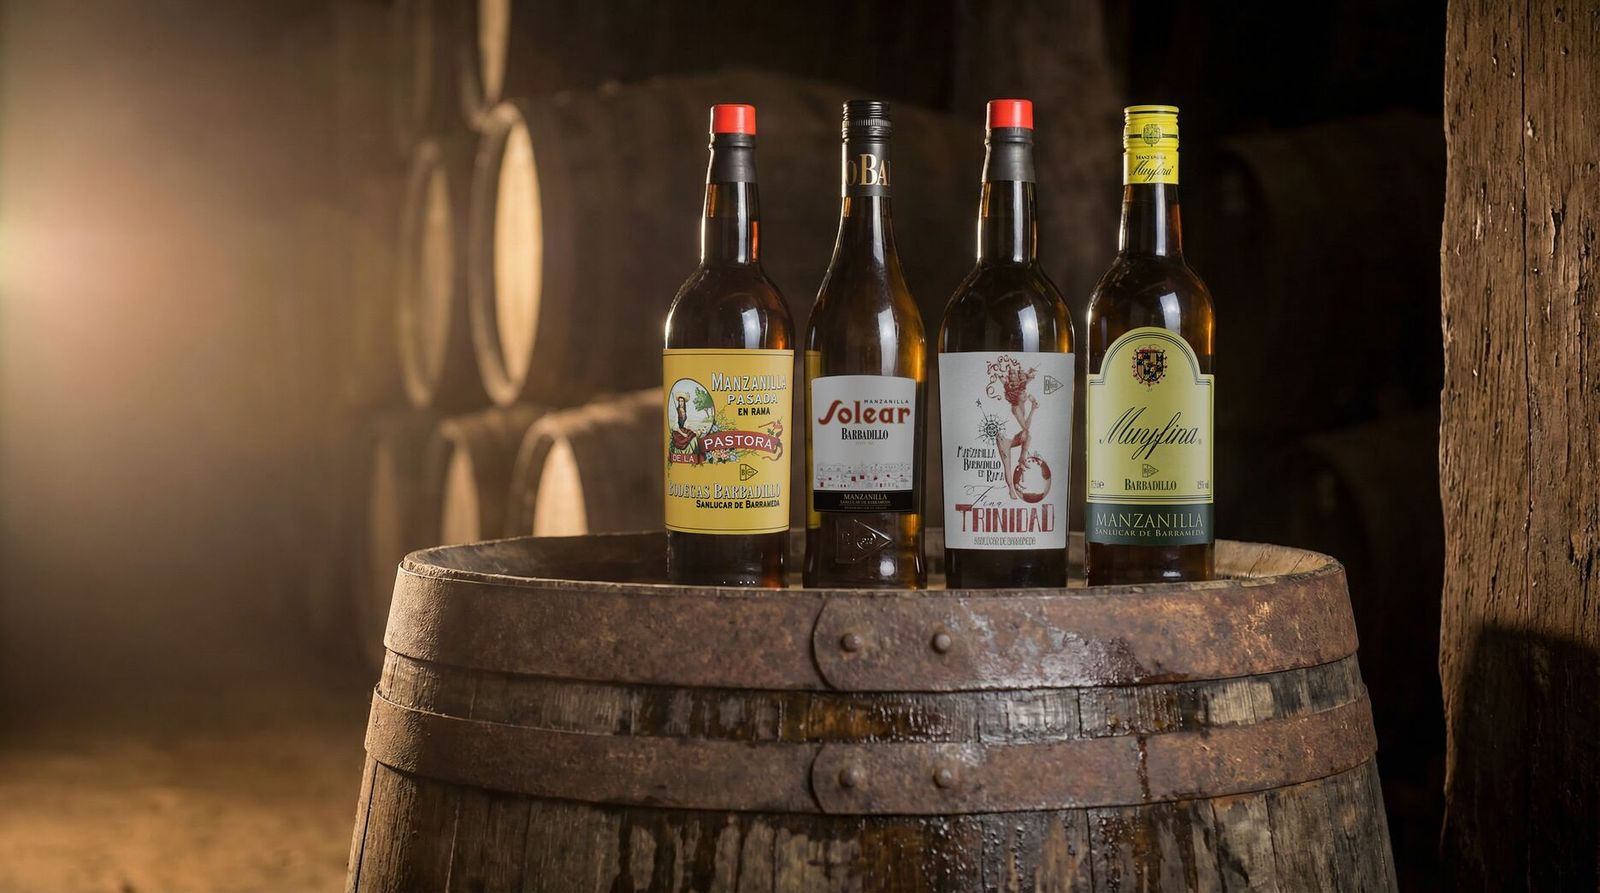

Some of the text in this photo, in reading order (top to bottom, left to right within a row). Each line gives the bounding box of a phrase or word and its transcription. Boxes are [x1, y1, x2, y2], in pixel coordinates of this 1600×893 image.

[711, 372, 787, 392] MANZANILLA
[727, 394, 778, 405] PASADA
[738, 407, 770, 416] EN RAMA
[818, 399, 911, 426] Solear
[841, 427, 889, 440] BARBADILLO
[1099, 406, 1199, 460] Muyfina
[704, 435, 773, 450] PASTORA
[672, 454, 695, 463] DE LA
[963, 459, 1002, 471] BARBADILLO
[714, 482, 781, 500] BARBADILLO
[1124, 478, 1177, 491] BARBADILLO
[696, 499, 780, 509] SANLUCAR DE BARRAMEDA
[955, 504, 1055, 533] TRINIDAD
[1096, 512, 1203, 528] MANZANILLA
[1094, 528, 1205, 538] SANLUCAR DE BARRAMEDA
